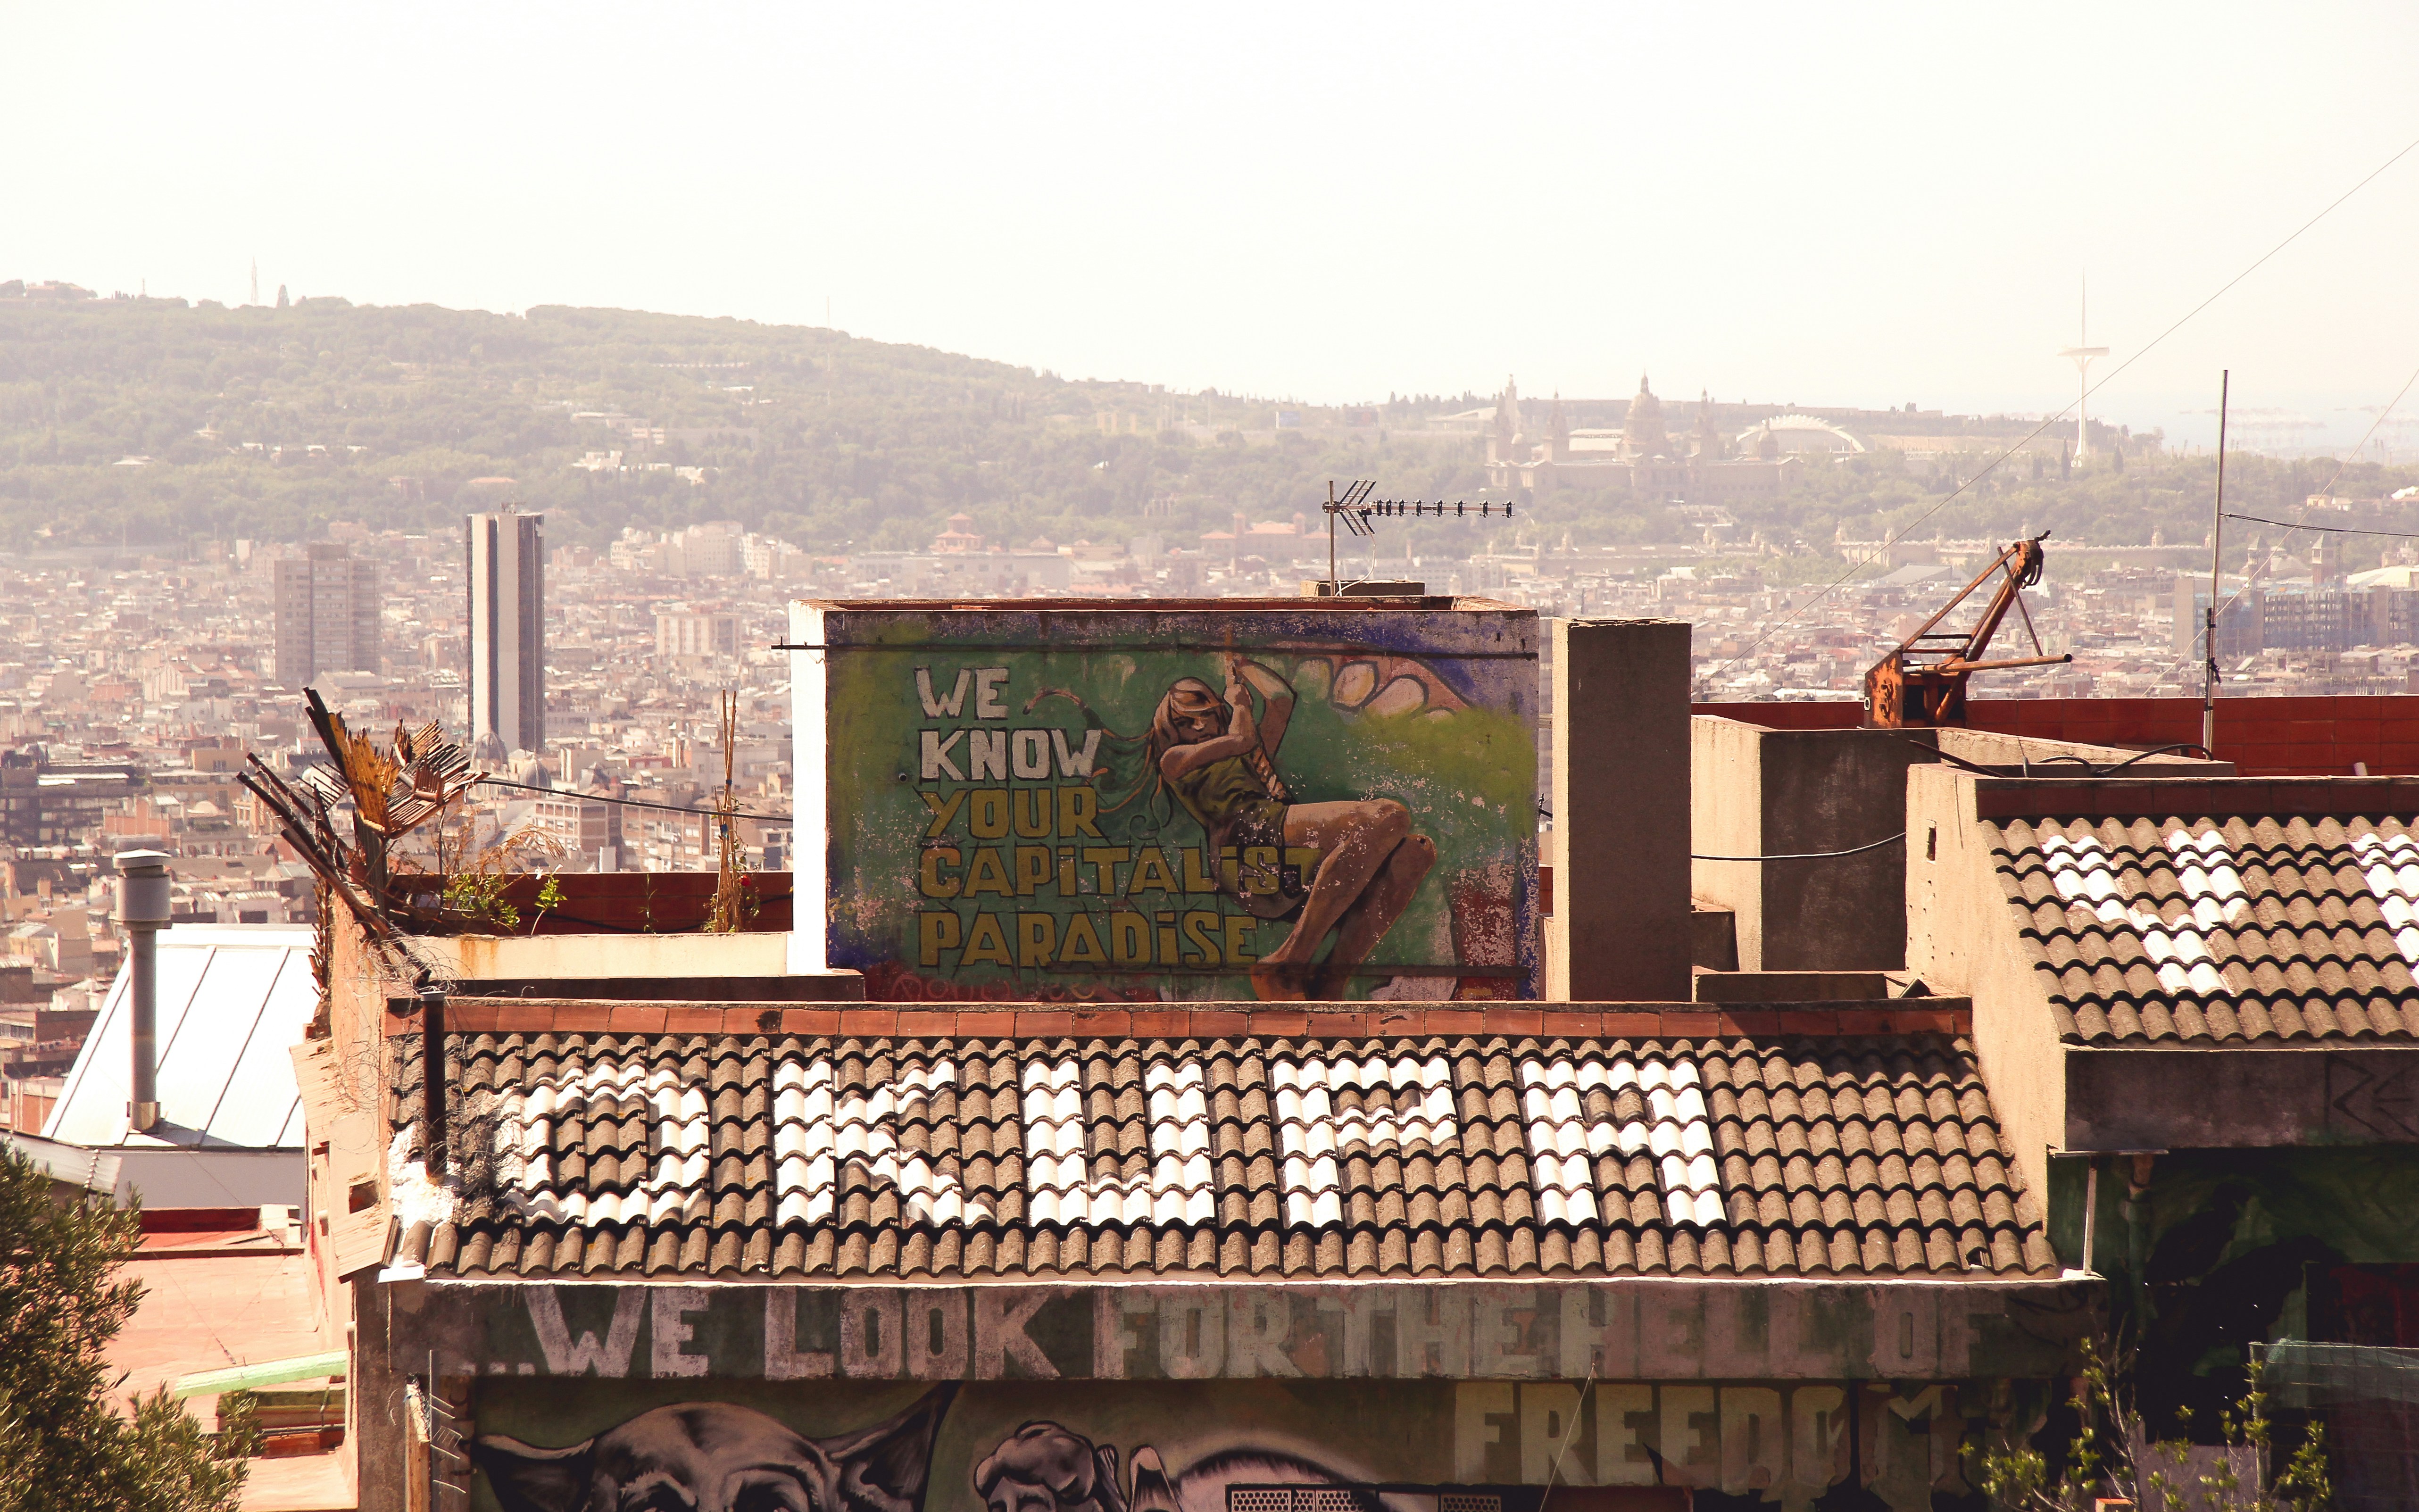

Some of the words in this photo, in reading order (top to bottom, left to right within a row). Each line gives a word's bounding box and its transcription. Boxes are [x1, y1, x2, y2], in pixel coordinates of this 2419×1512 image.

[914, 665, 1010, 720] WE
[918, 727, 1102, 783] KNOW
[914, 785, 1108, 841] YOUR
[493, 1056, 1726, 1229] OKUPA
[764, 1285, 1061, 1381] LOOK
[1092, 1285, 1306, 1379] FOR
[1317, 1285, 1537, 1378] THE
[1560, 1285, 1856, 1378] HELL
[1872, 1285, 2005, 1378] OF
